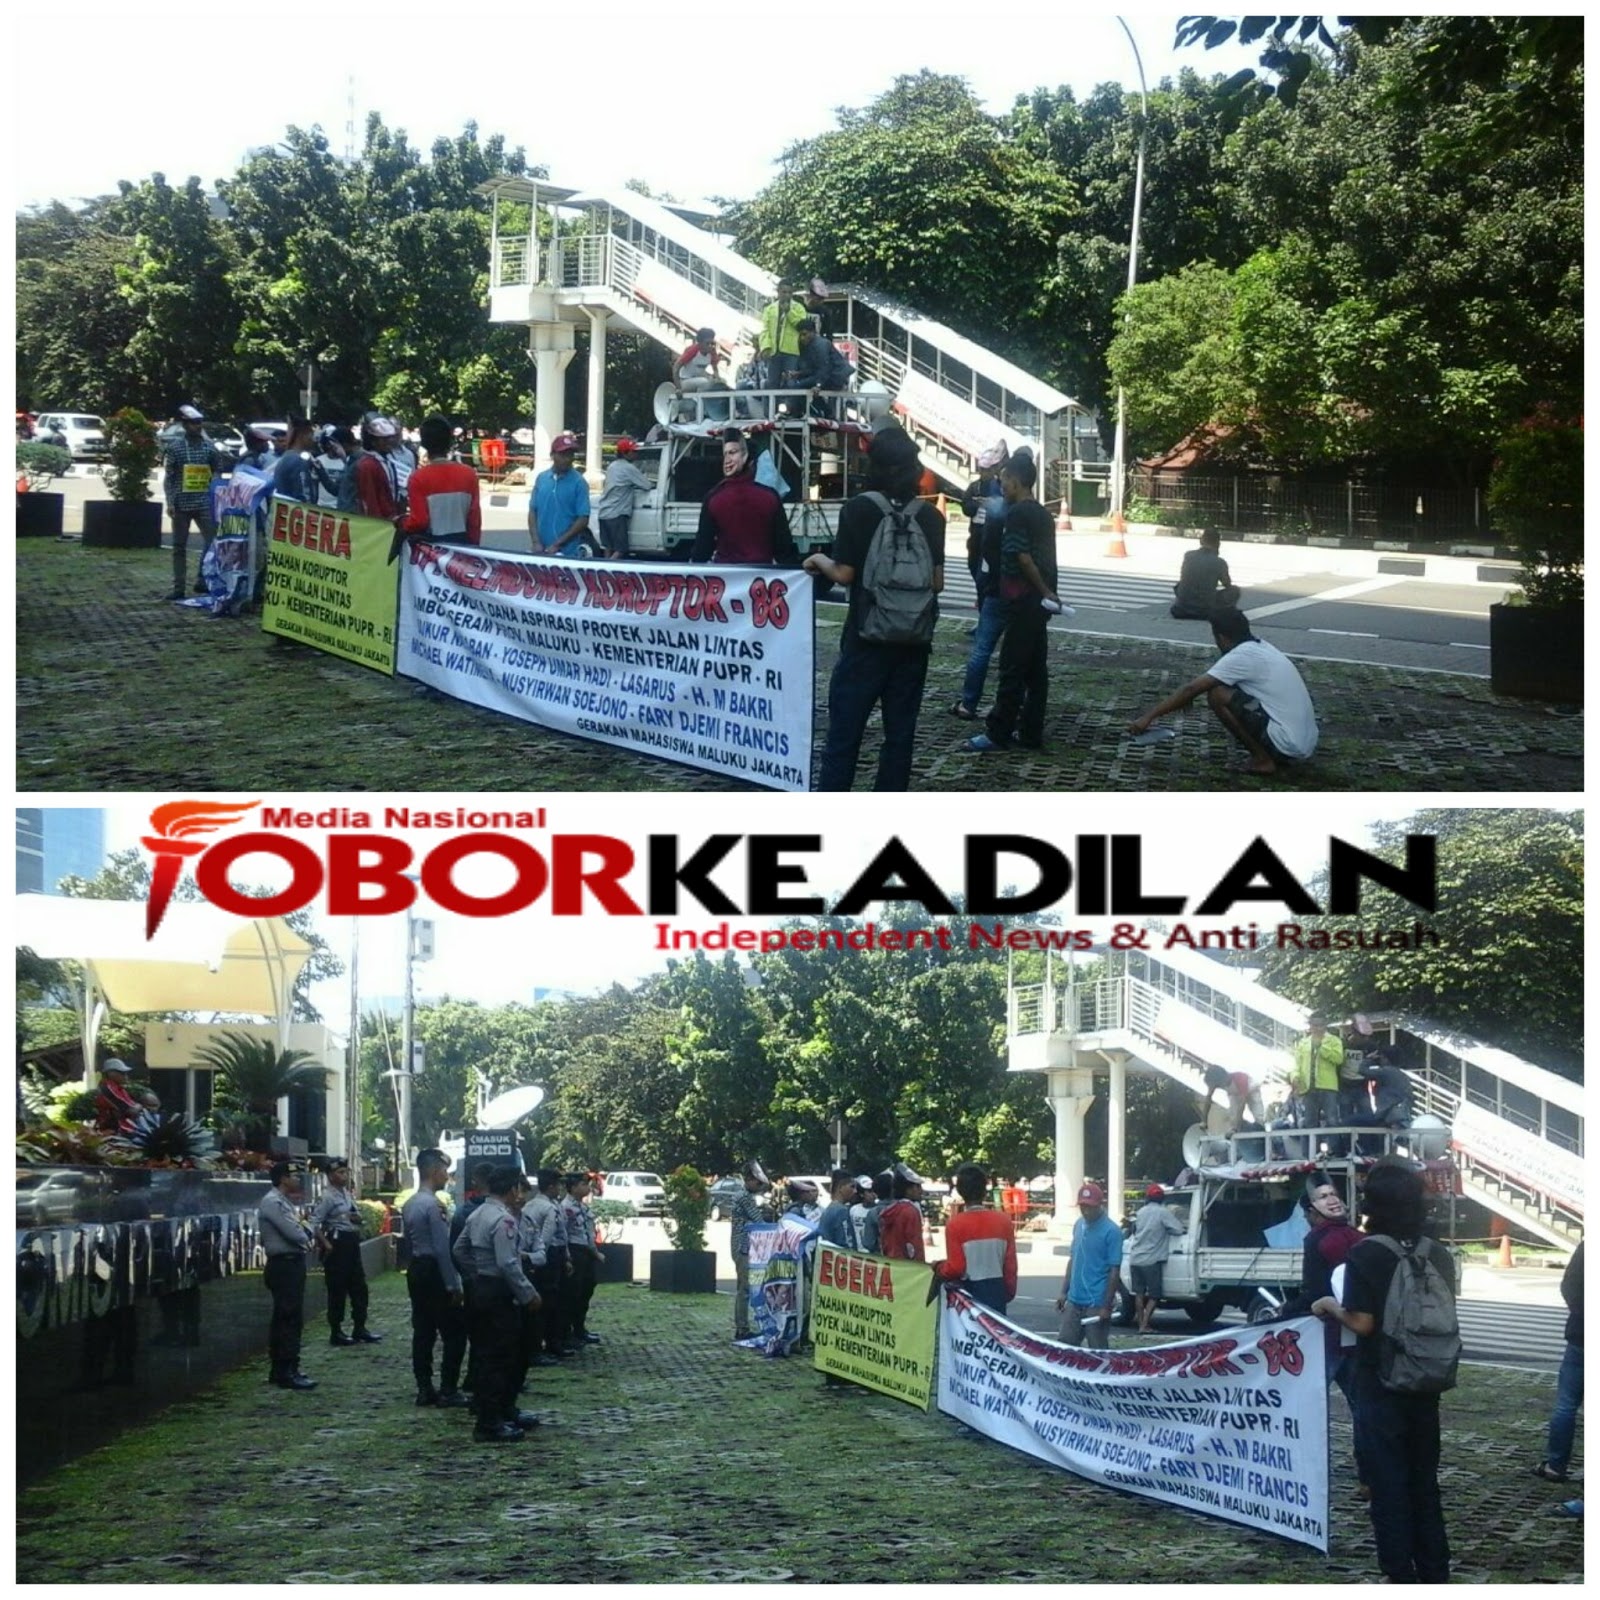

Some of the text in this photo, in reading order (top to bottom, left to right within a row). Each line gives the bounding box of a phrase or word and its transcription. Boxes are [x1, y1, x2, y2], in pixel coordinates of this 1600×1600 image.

[273, 503, 352, 560] EGERA
[294, 578, 319, 599] JALAN
[321, 585, 351, 610] LINTAS
[302, 560, 348, 587] KORUPTOR
[578, 567, 728, 623] KORUPTOR
[749, 577, 790, 629] 86
[286, 595, 346, 629] KEMENTERIAN
[347, 615, 375, 639] PUPR
[521, 609, 578, 634] ASPIRASI
[581, 619, 643, 644] PROYEK
[648, 629, 699, 651] JALAN
[704, 634, 764, 660] LINTAS
[502, 646, 546, 673] YOSEPH
[549, 658, 580, 683] UMAR
[583, 664, 612, 689] HADI
[620, 671, 676, 703] LASARUS
[692, 687, 709, 707] H.
[714, 688, 725, 711] M
[729, 692, 773, 722] BAKRI
[526, 630, 580, 655] MALUKU
[593, 641, 700, 676] KEMENTERIAN
[703, 659, 752, 684] PUPR
[766, 669, 782, 691] RI
[502, 671, 571, 705] NUSYIRWAN
[573, 691, 627, 720] SOEJONO
[638, 704, 673, 728] FARY
[679, 711, 720, 740] DJEMI
[724, 720, 789, 756] FRANCIS
[577, 718, 803, 786] GERAKAN MAHASISWA MALUKU JAKARTA
[819, 1250, 895, 1303] EGERA
[841, 1319, 866, 1340] JALAN
[867, 1326, 896, 1349] LINTAS
[849, 1301, 893, 1329] KORUPTOR
[815, 1330, 828, 1347] KU
[835, 1335, 891, 1368] KEMENTERIAN
[892, 1354, 918, 1377] PUPR
[1095, 1382, 1157, 1402] PROYEK
[1161, 1388, 1220, 1403] JALAN
[1224, 1386, 1282, 1408] LINTAS
[1113, 1401, 1222, 1428] KEMENTERIAN
[1220, 1411, 1271, 1433] PUPR
[1284, 1417, 1300, 1439] RI
[1034, 1419, 1104, 1457] NUSYIRWAN
[1102, 1442, 1150, 1474] SOEJONO
[1160, 1457, 1199, 1479] FARY
[1202, 1462, 1244, 1490] DJEMI
[1248, 1472, 1308, 1508] FRANCIS
[1150, 1426, 1194, 1455] LASARUS
[1210, 1438, 1232, 1457] H.
[1235, 1438, 1248, 1460] M
[1252, 1441, 1292, 1472] BAKRI
[1159, 1479, 1221, 1507] MAHASISWA
[1224, 1495, 1270, 1519] MALUKU
[1273, 1511, 1323, 1539] JAKARTA
